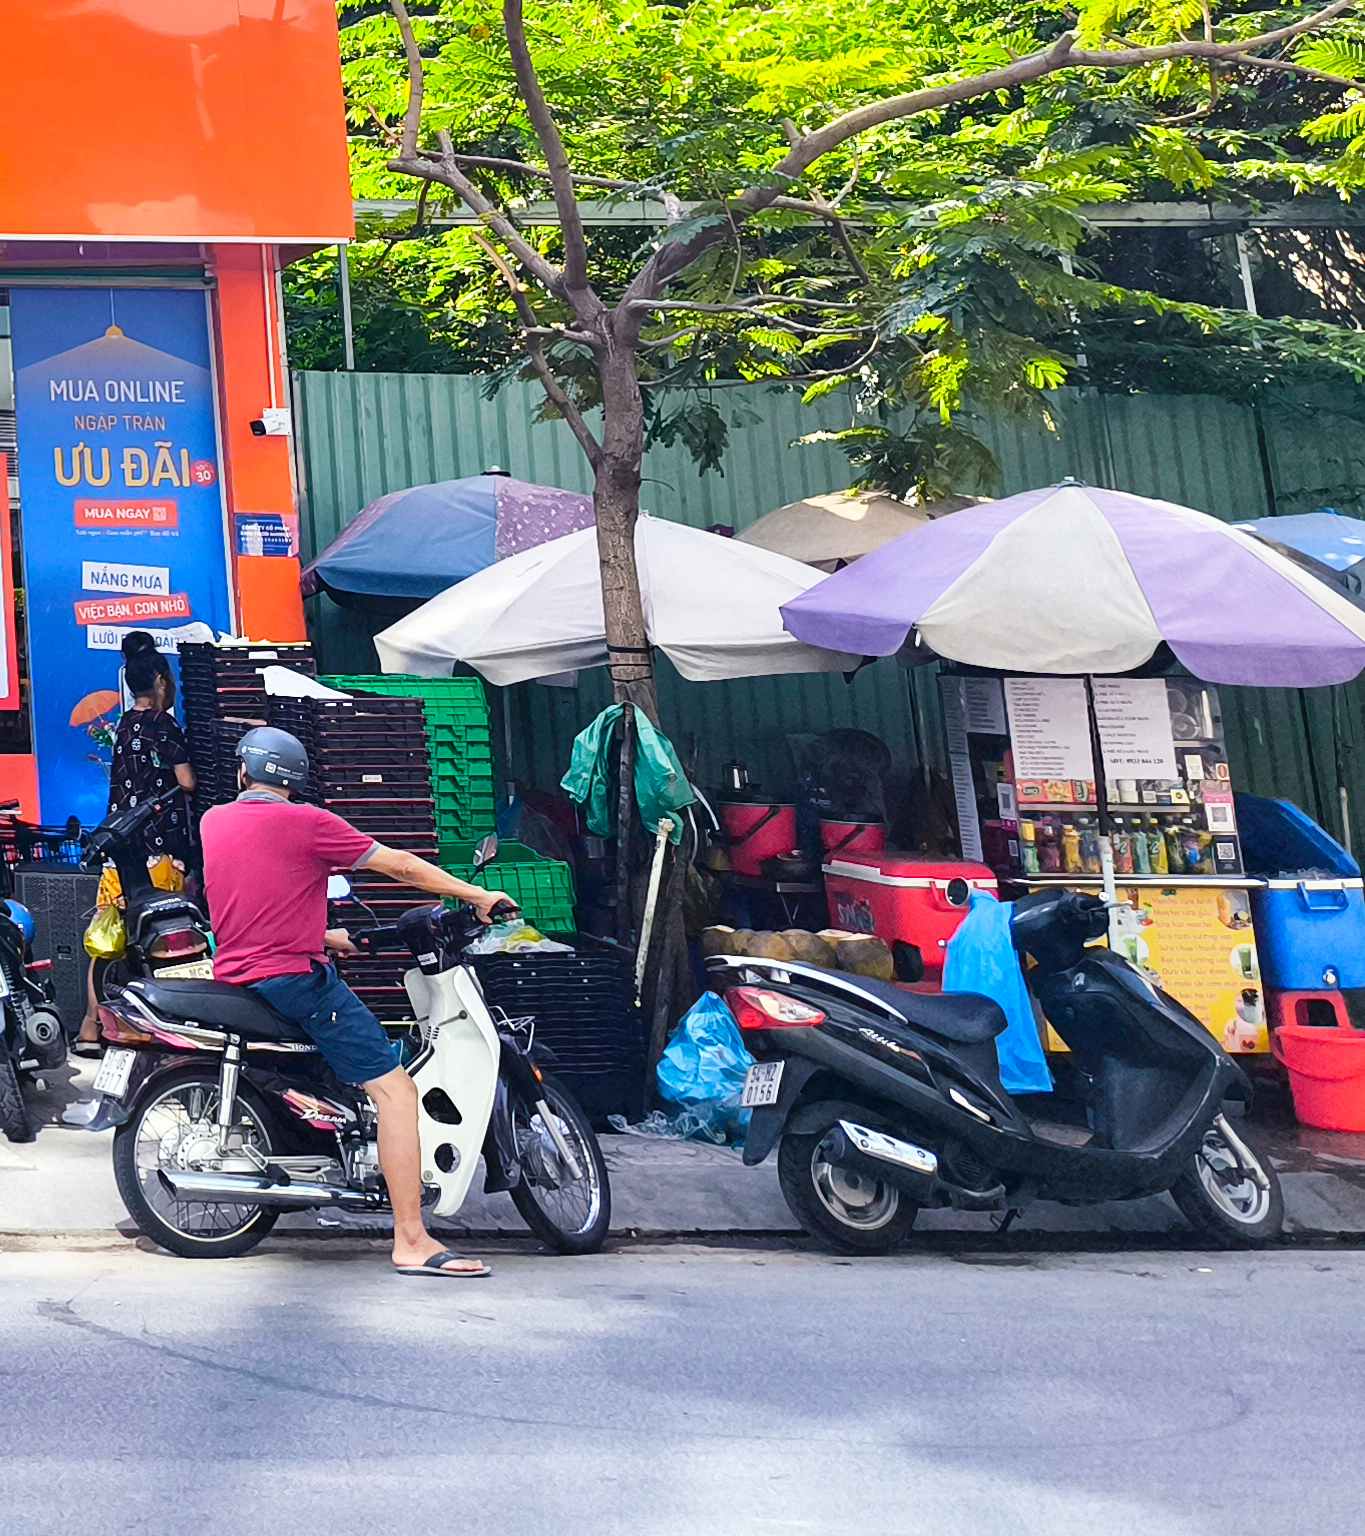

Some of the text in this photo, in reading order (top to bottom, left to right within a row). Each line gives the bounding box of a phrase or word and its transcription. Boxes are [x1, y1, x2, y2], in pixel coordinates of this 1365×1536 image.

[50, 380, 185, 402] MUA ONLINE
[75, 413, 165, 432] NGẬP TRÀN
[54, 441, 191, 487] ƯU ĐÃI
[85, 508, 150, 519] MUA NGAY
[91, 566, 163, 589] NẮNG MƯA
[79, 596, 185, 620] VIỆC BẬN, CON NHỎ
[93, 631, 118, 644] LƯỜI
[746, 1084, 773, 1104] 0156
